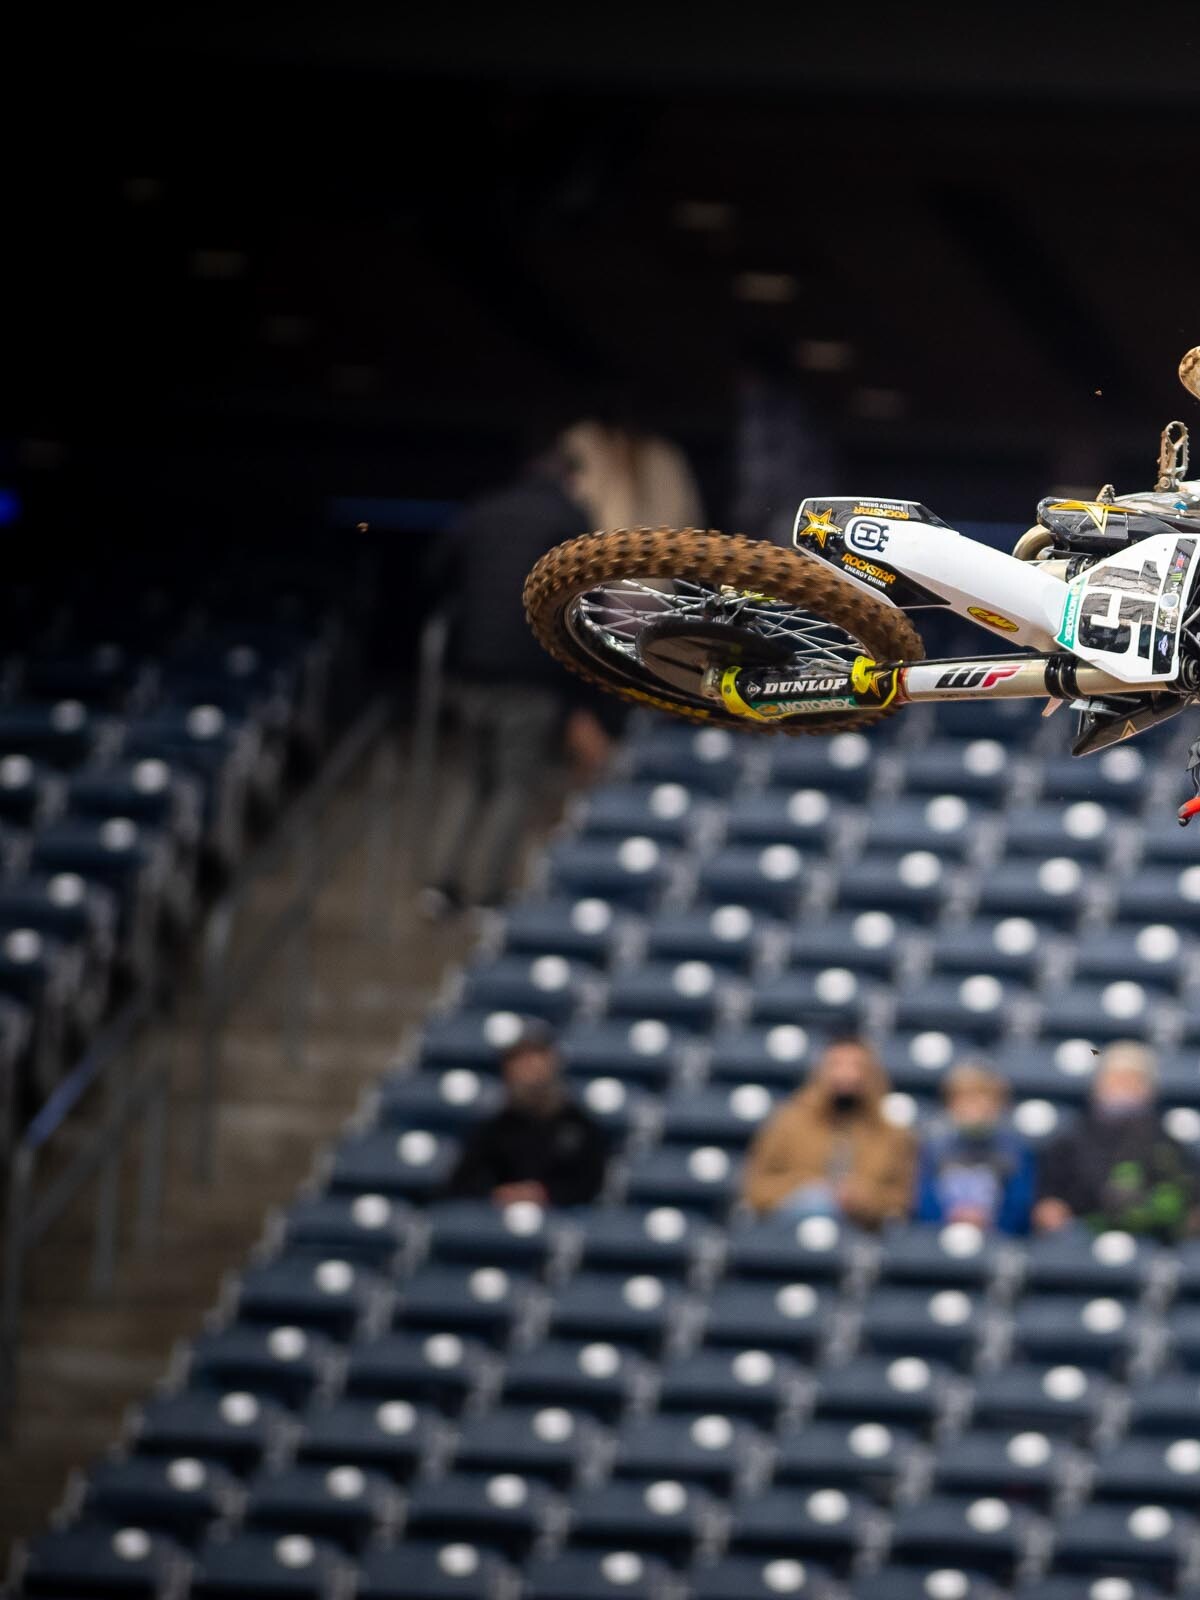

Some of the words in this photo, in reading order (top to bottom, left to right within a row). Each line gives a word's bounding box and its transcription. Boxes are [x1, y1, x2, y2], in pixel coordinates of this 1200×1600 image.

[841, 553, 897, 585] ROCKSTAR
[843, 564, 868, 580] ENERGY
[867, 574, 887, 588] DRINK
[763, 678, 848, 695] DUNLOP
[777, 698, 856, 713] MOTOREX
